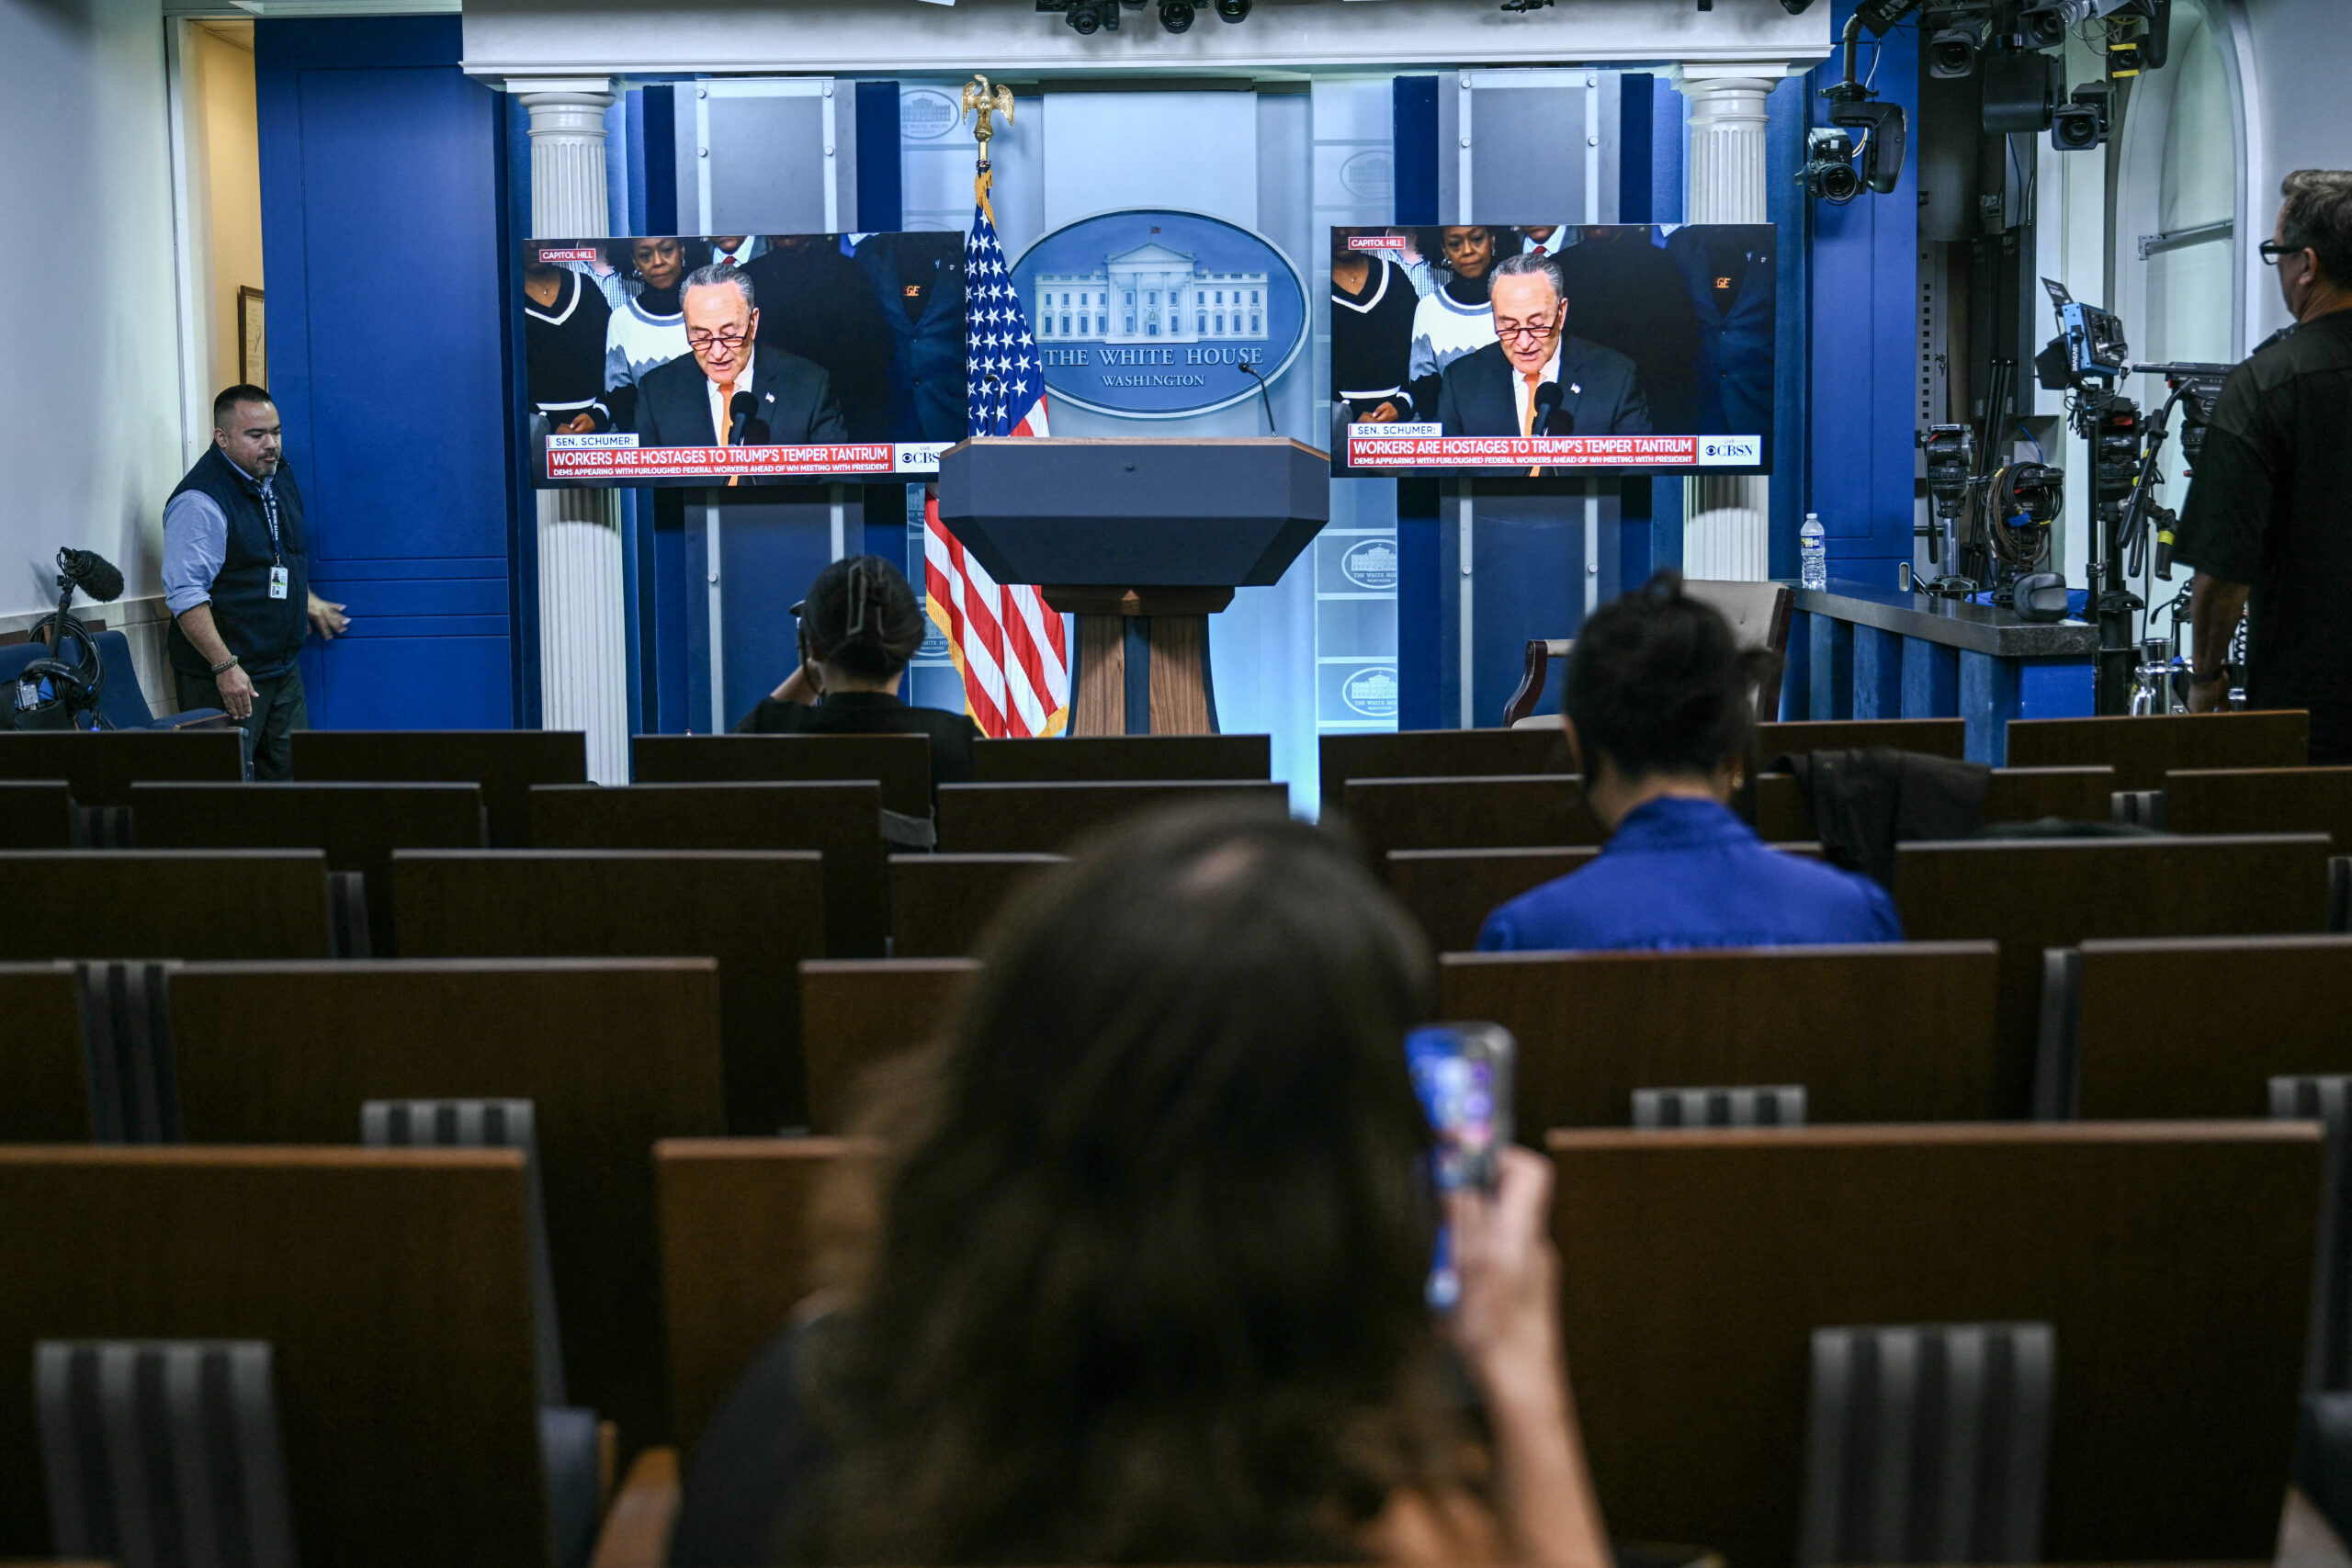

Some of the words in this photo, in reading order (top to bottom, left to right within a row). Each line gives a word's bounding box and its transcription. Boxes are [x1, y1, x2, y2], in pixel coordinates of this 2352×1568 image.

[1351, 239, 1385, 247] CAPITOL
[1385, 239, 1402, 247] HILL
[542, 252, 575, 260] CAPITOL
[577, 251, 594, 259] HILL
[1044, 349, 1090, 366] THE
[1098, 348, 1175, 367] WHITE
[1186, 347, 1264, 366] HOUSE
[1102, 374, 1205, 388] WASHINGTON
[1357, 426, 1379, 434] SEN.
[1384, 425, 1436, 434] SCHUMER:
[556, 437, 577, 446] SEN.
[581, 436, 634, 446] SCHUMER:
[1353, 441, 1415, 455] WORKERS
[1417, 441, 1441, 454] ARE
[1442, 441, 1509, 454] HOSTAGES
[1511, 440, 1529, 454] TO
[1532, 440, 1583, 454] TRUMP'S
[1585, 439, 1631, 453] TEMPER
[1634, 439, 1691, 453] TANTRUM
[552, 452, 612, 467] WORKERS
[615, 451, 639, 465] ARE
[640, 450, 707, 464] HOSTAGES
[708, 449, 726, 463] TO
[729, 448, 779, 463] TRUMP'S
[782, 447, 828, 462] TEMPER
[830, 446, 888, 461] TANTRUM
[1716, 445, 1753, 457] CBSN
[912, 452, 940, 463] CBS
[574, 468, 614, 476] APPEARING
[635, 467, 682, 475] FURLOUGHED
[786, 464, 799, 472] WH
[800, 464, 831, 472] MEETING
